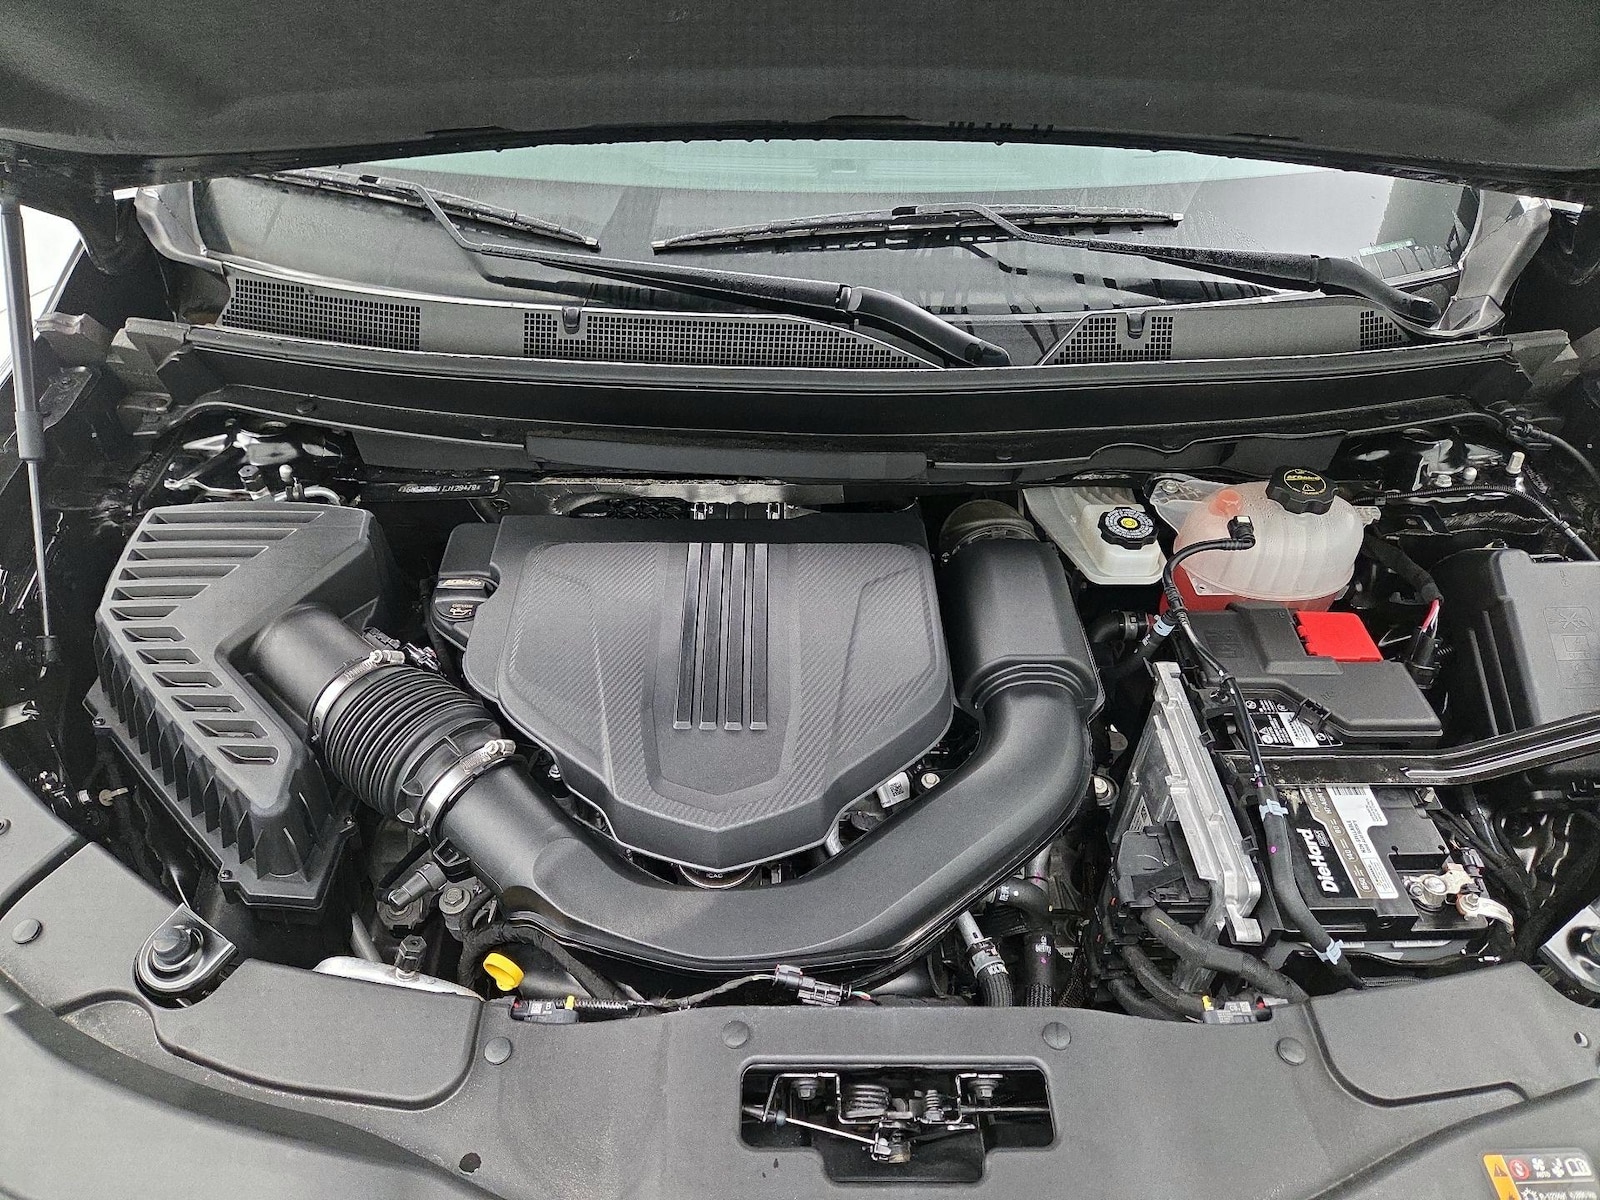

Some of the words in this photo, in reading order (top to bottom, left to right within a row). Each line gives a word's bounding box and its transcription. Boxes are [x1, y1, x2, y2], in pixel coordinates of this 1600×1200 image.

[1286, 474, 1321, 482] ACDelco
[1296, 828, 1339, 893] DieHard
[1345, 849, 1355, 861] 140
